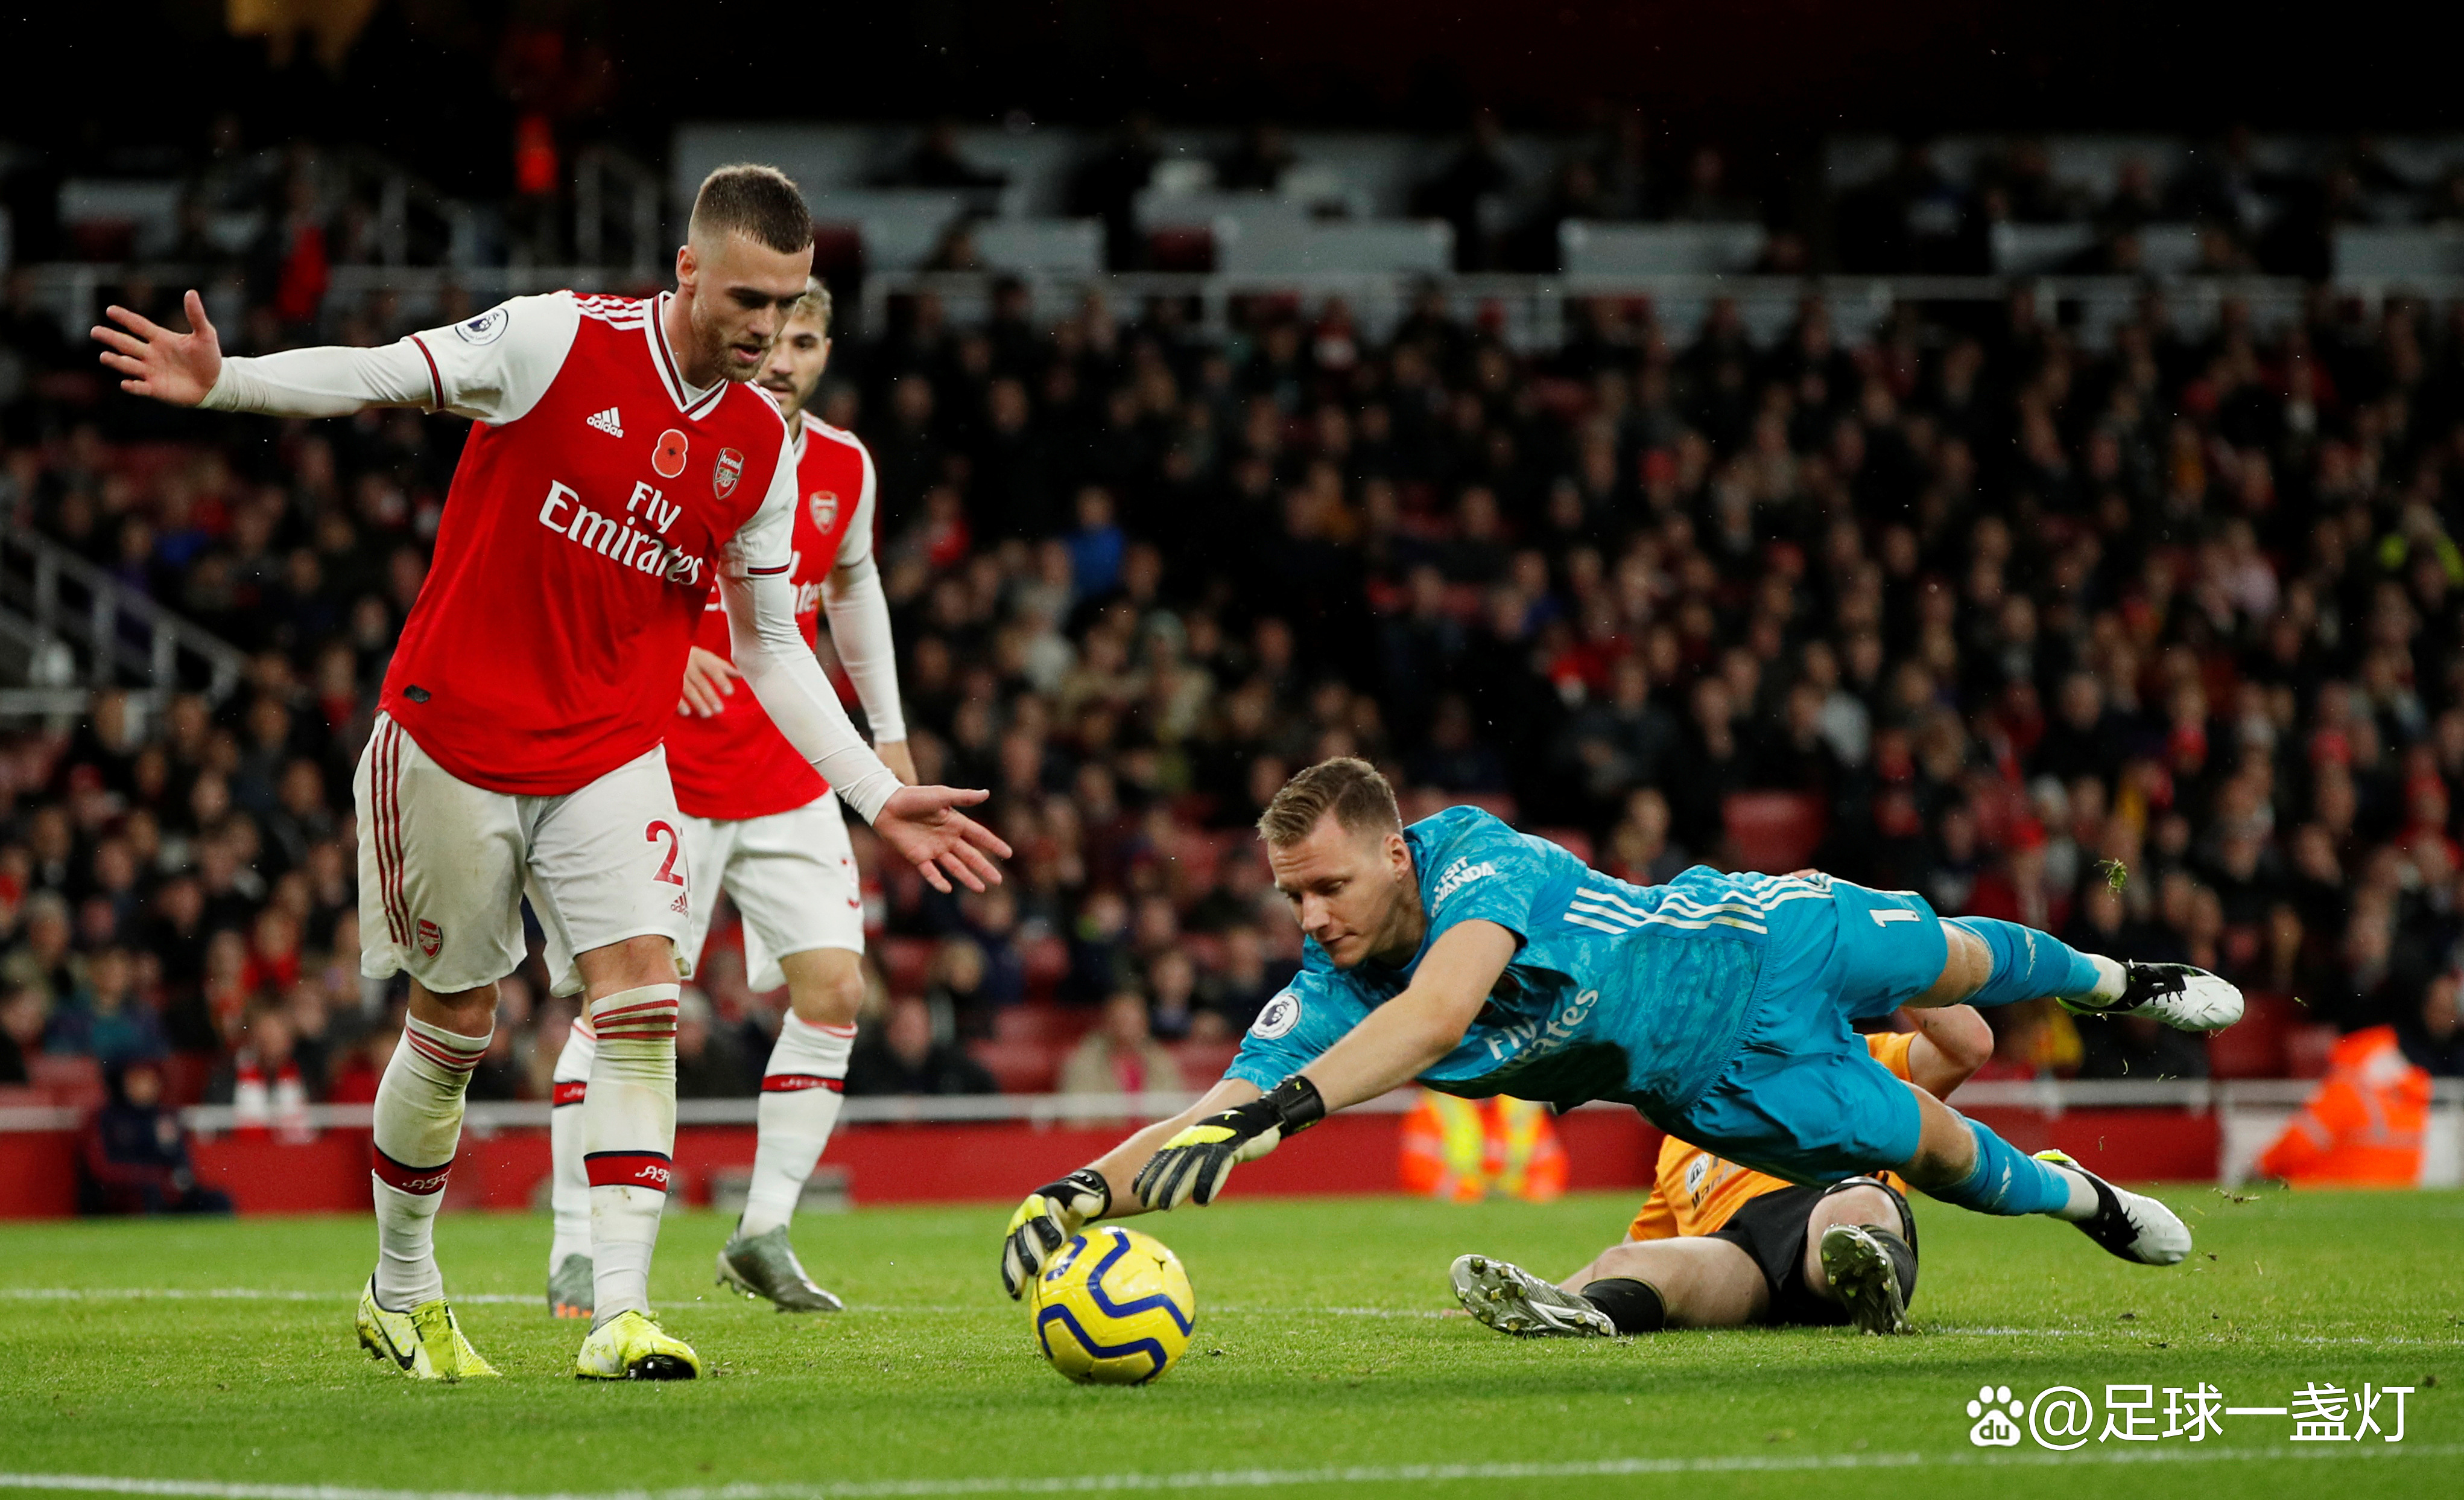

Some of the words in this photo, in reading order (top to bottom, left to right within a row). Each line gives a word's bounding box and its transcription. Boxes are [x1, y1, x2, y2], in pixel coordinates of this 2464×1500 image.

[586, 416, 624, 438] adidas
[626, 480, 682, 534] Fly
[539, 480, 703, 585] Emirates
[1869, 909, 1921, 927] 1
[1484, 1017, 1536, 1060] Fly
